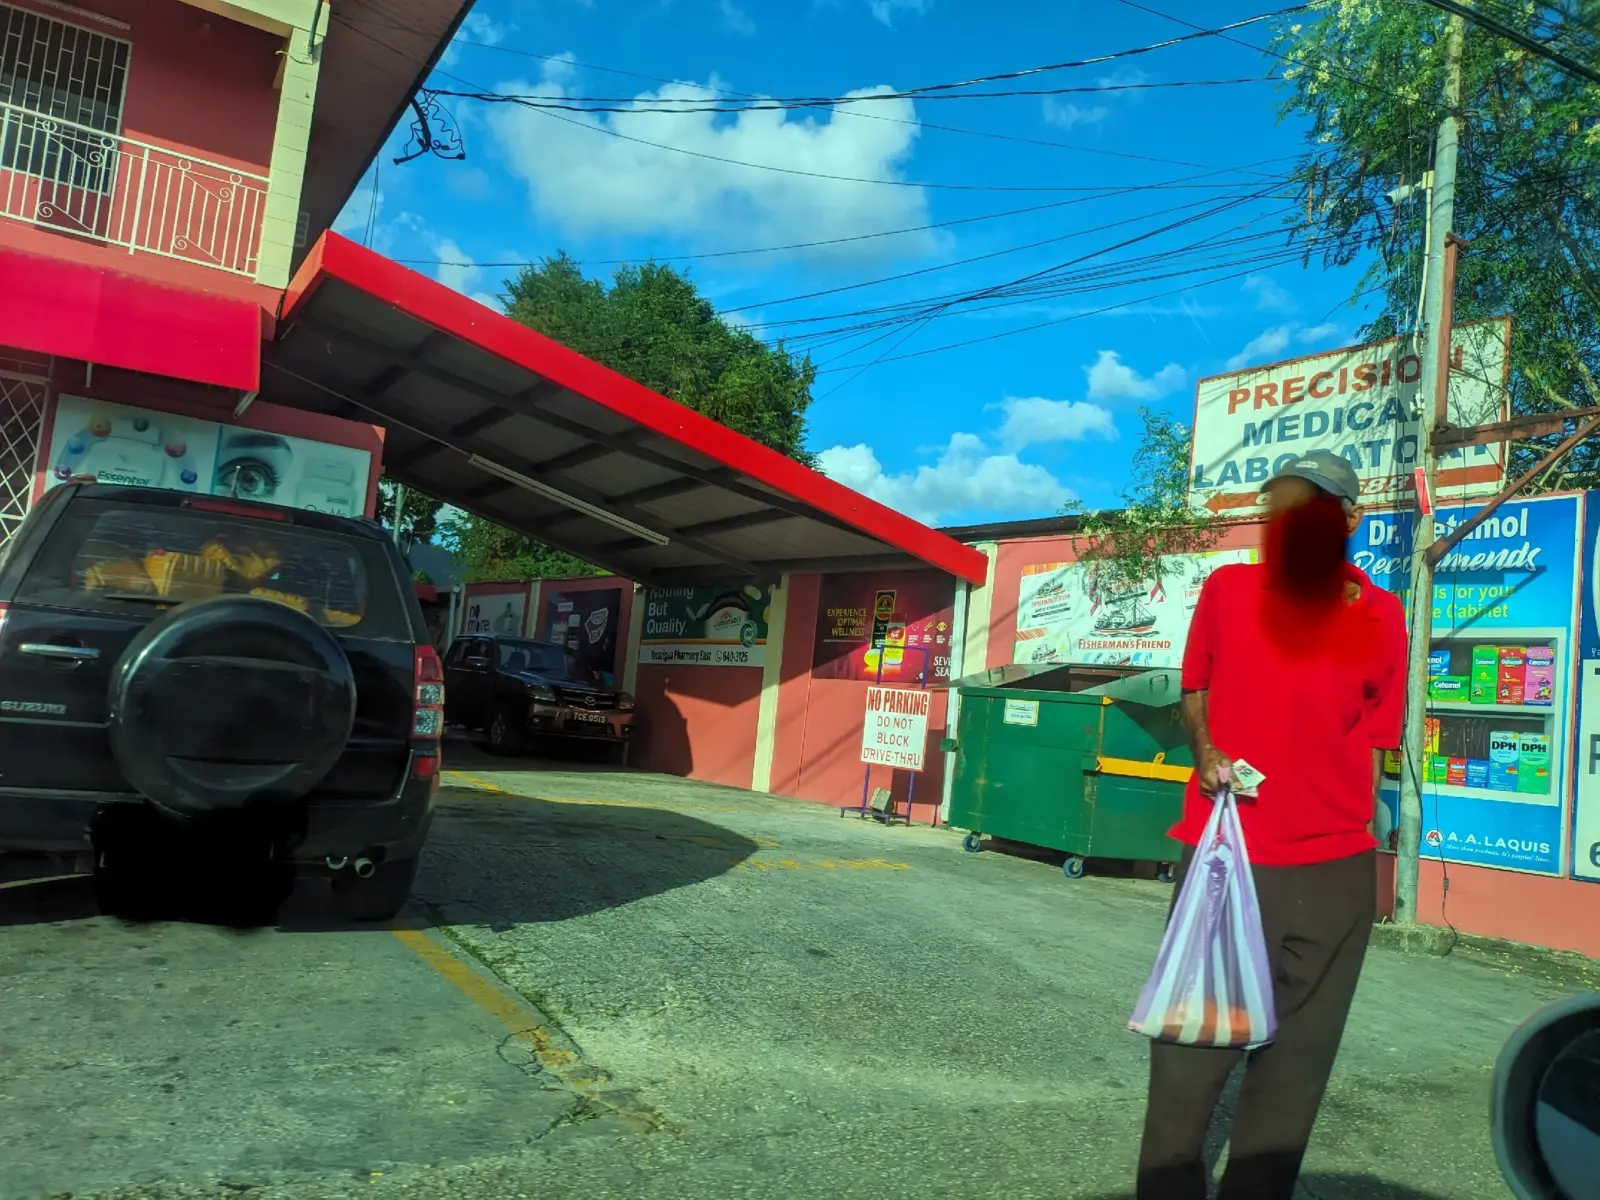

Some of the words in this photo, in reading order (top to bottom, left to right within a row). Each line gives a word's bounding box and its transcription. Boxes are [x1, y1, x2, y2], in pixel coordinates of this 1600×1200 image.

[1194, 434, 1486, 488] LABATO
[1369, 520, 1400, 546] Dr.
[1412, 508, 1528, 542] etmol
[1354, 541, 1541, 575] Recmends
[648, 602, 668, 617] But
[827, 608, 868, 617] EXPERIENCE
[646, 618, 688, 636] Quality.
[837, 617, 866, 626] OPTIMAL
[831, 627, 865, 637] WELLNESS
[1135, 638, 1171, 649] FRIEND
[933, 655, 952, 667] SEVE
[935, 666, 950, 677] SEA
[0, 700, 67, 715] SUZUKI
[868, 689, 881, 711] NO
[883, 690, 928, 716] PARKING
[877, 715, 890, 728] DO
[893, 717, 914, 730] NOT
[877, 732, 910, 747] BLOCK
[1491, 741, 1517, 751] DPH
[1521, 743, 1547, 752] DPH
[863, 747, 920, 766] DRIVE-THRU
